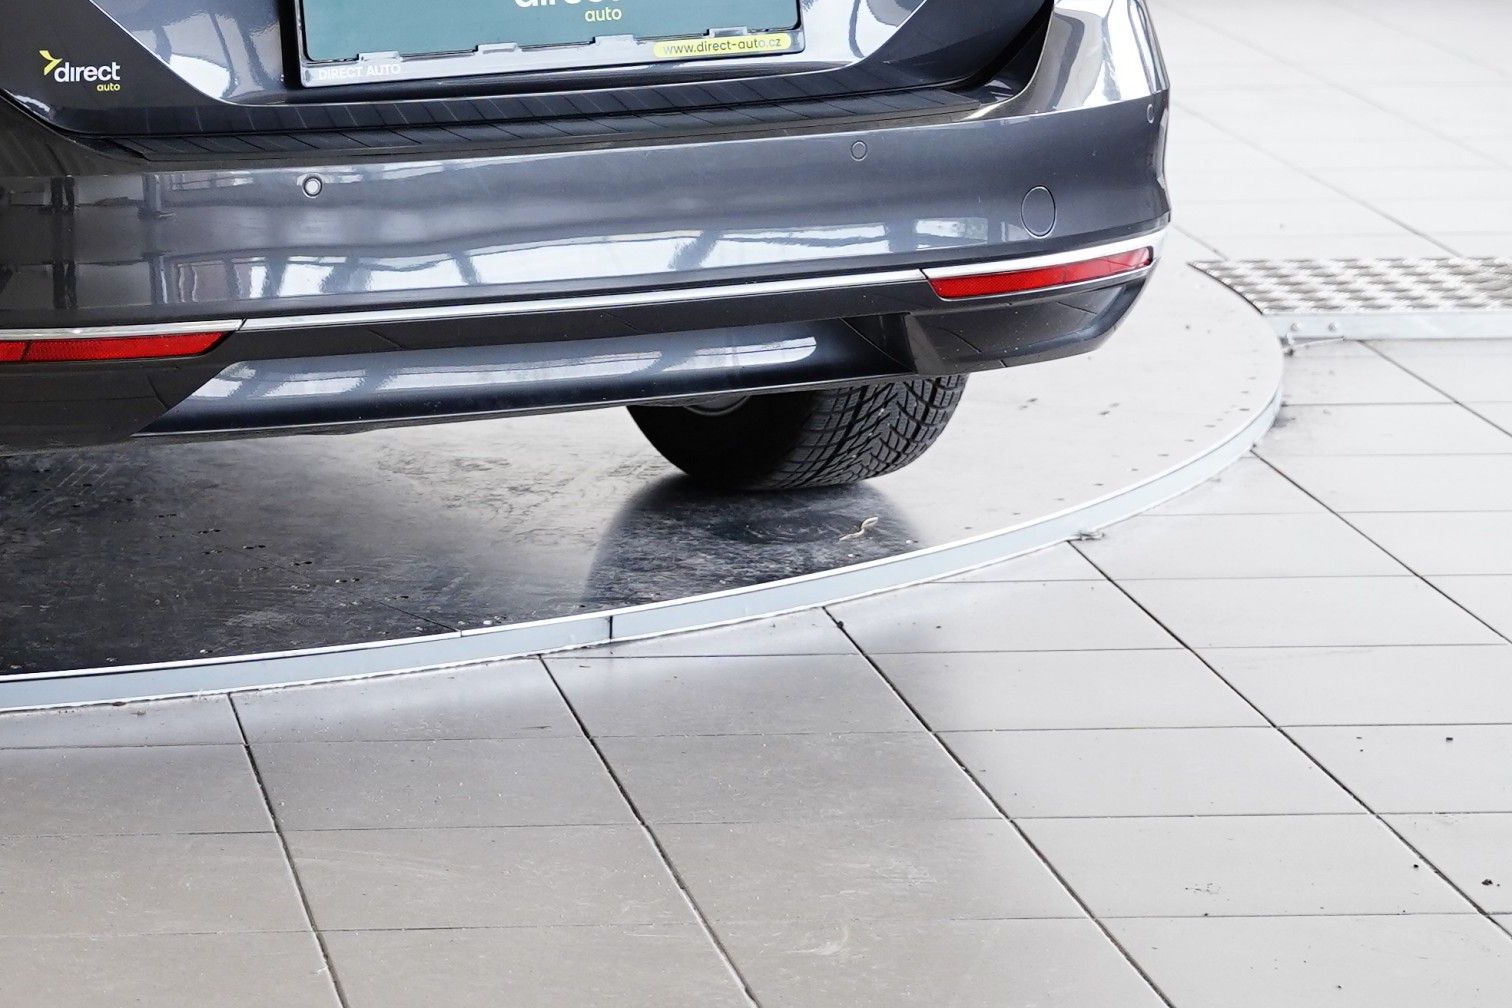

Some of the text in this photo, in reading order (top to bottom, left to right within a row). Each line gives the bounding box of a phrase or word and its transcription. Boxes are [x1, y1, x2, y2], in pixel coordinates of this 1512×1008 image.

[584, 6, 622, 22] auto
[662, 37, 782, 55] www.direct-auto.cz
[53, 61, 121, 83] direct
[318, 63, 402, 81] DIRECT AUTO
[96, 82, 121, 92] auto
